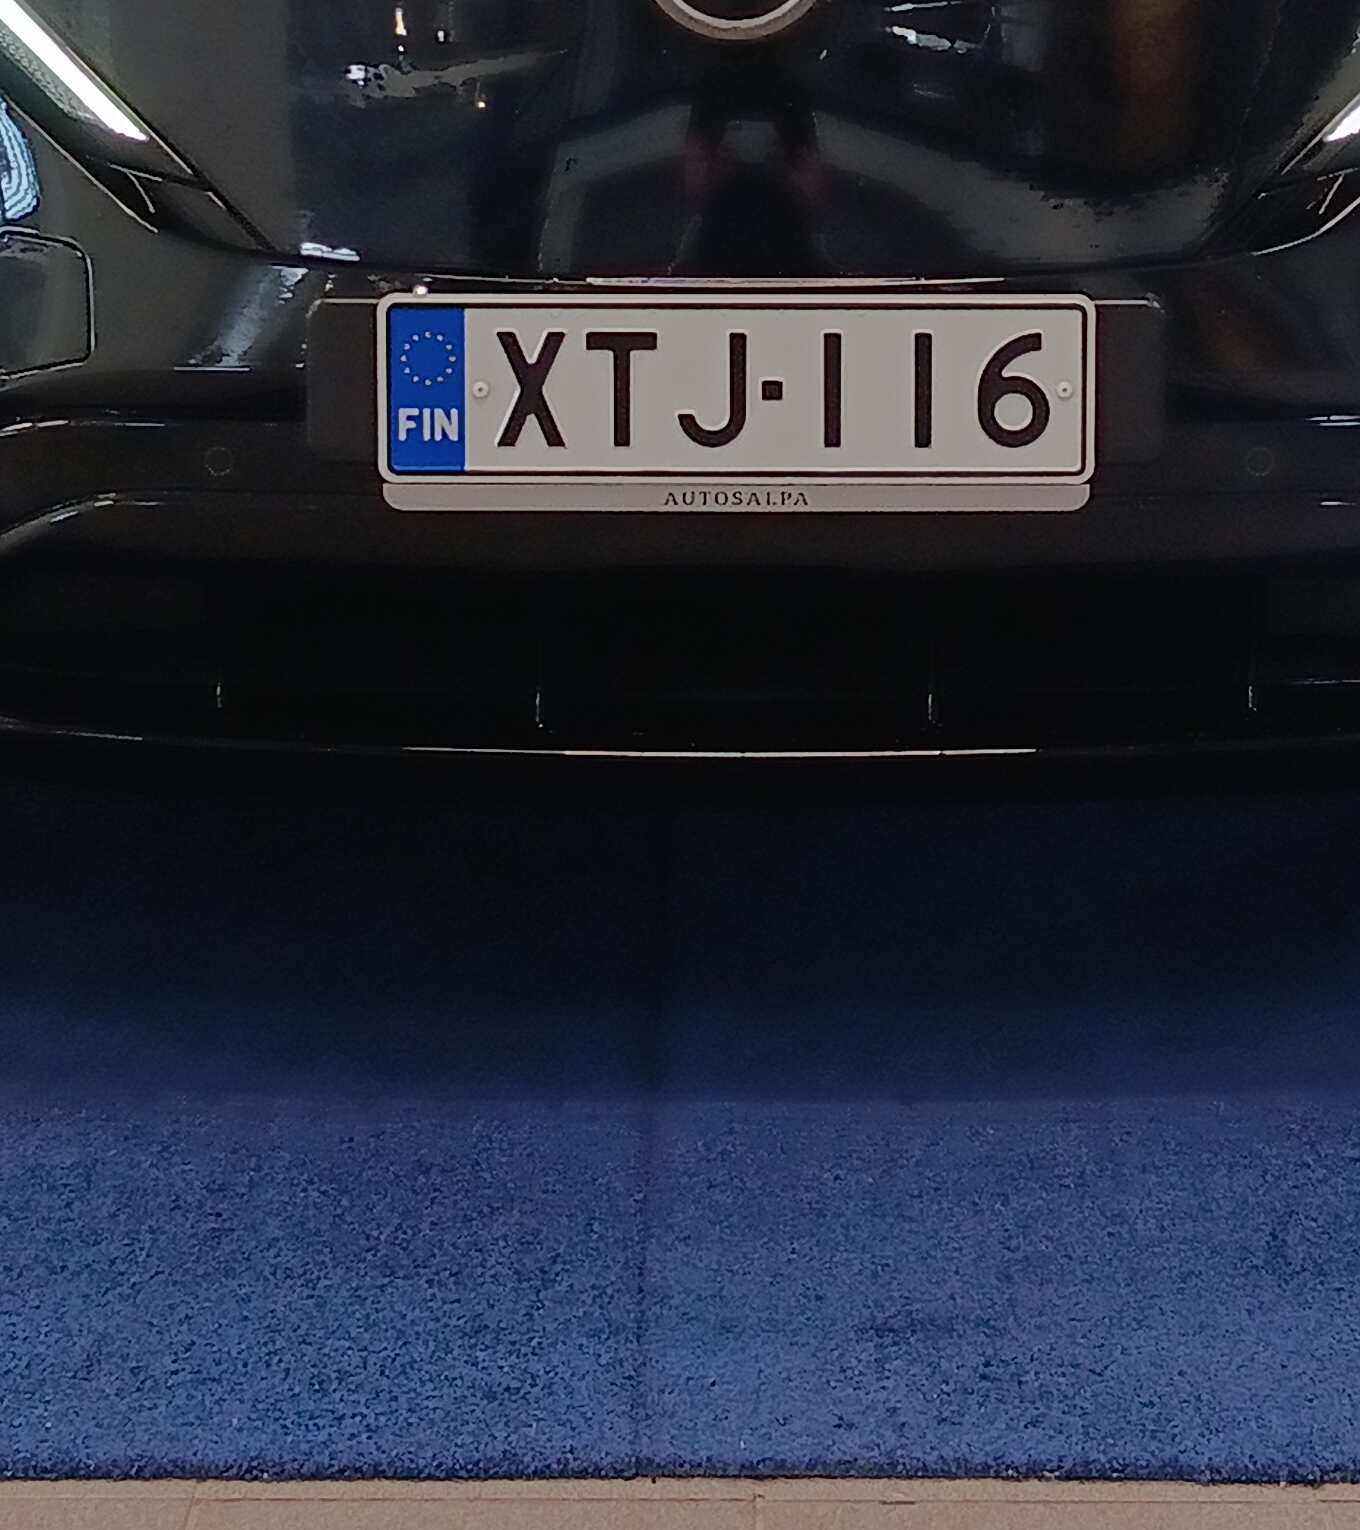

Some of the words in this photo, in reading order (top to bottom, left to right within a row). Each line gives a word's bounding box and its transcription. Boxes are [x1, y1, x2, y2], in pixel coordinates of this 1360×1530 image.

[497, 331, 1050, 448] XTJ-116
[397, 407, 459, 442] FIN
[664, 490, 809, 506] AUTOSALPA
